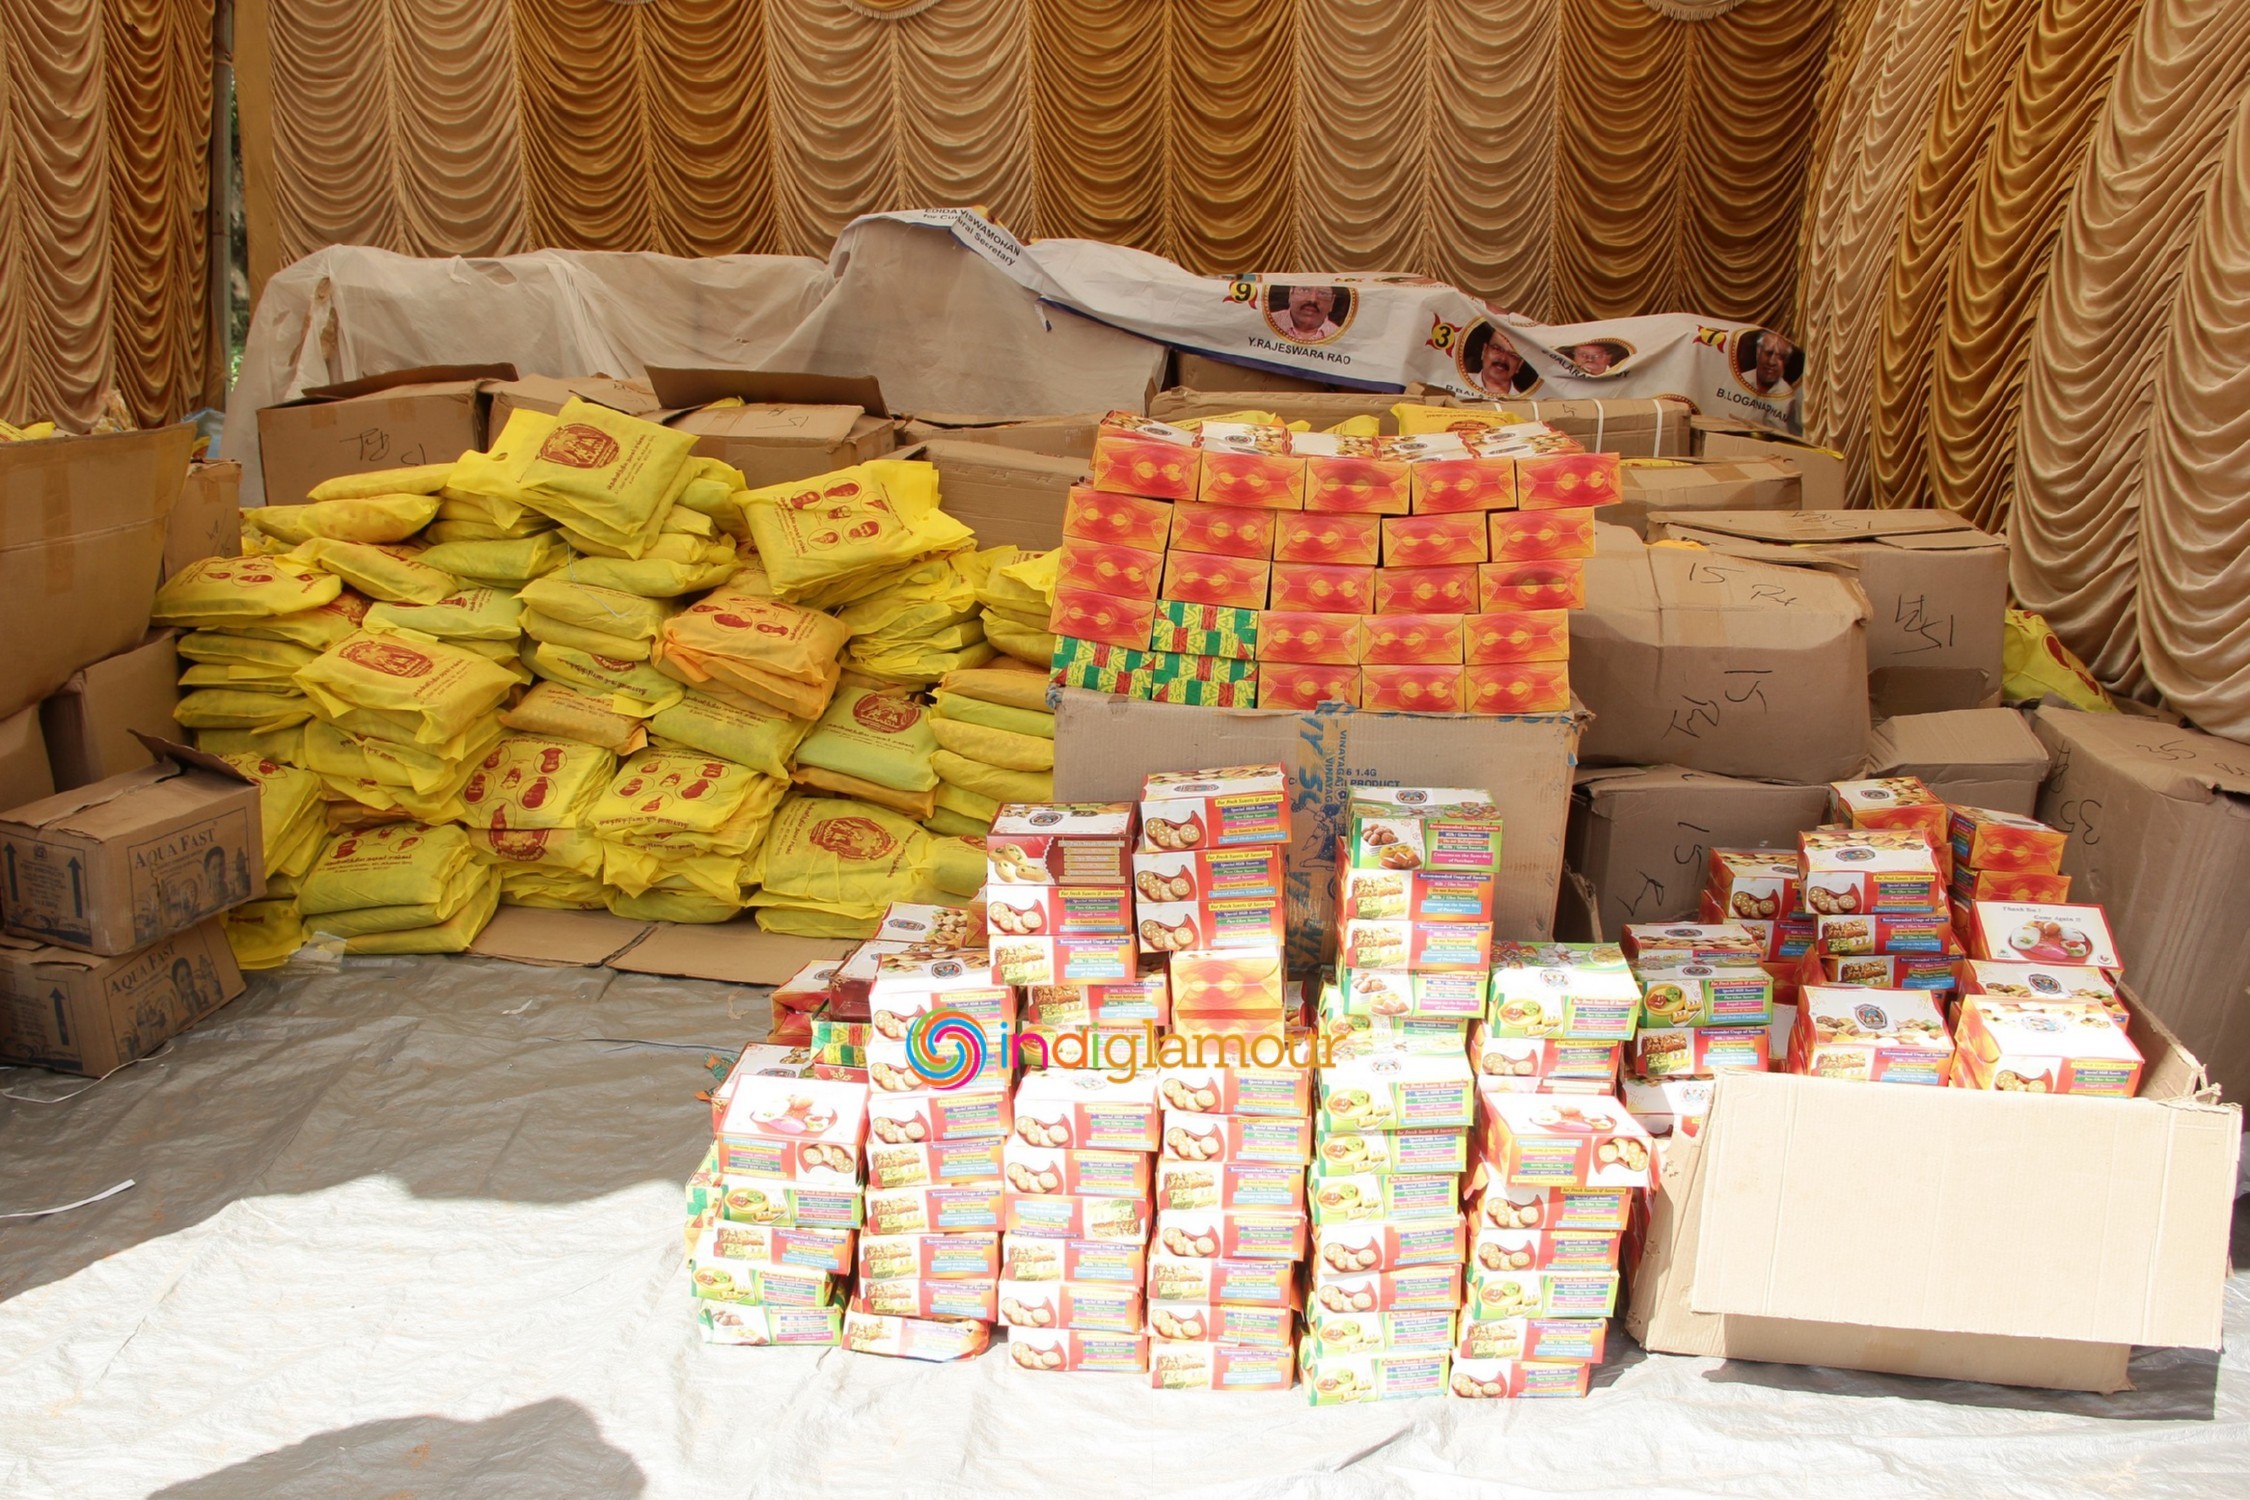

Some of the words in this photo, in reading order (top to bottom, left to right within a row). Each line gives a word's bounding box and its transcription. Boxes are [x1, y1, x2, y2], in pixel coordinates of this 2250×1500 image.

[960, 208, 1021, 257] VISWAMOHAN
[974, 231, 1017, 267] Secretary
[1234, 282, 1251, 301] 9
[1434, 325, 1451, 348] 3
[1706, 328, 1721, 344] 7
[1247, 336, 1325, 361] Y.RAJESWARA
[1326, 352, 1352, 365] RAO
[1355, 768, 1377, 777] 1.4G
[134, 842, 179, 870] AQUA
[179, 827, 216, 853] FAST
